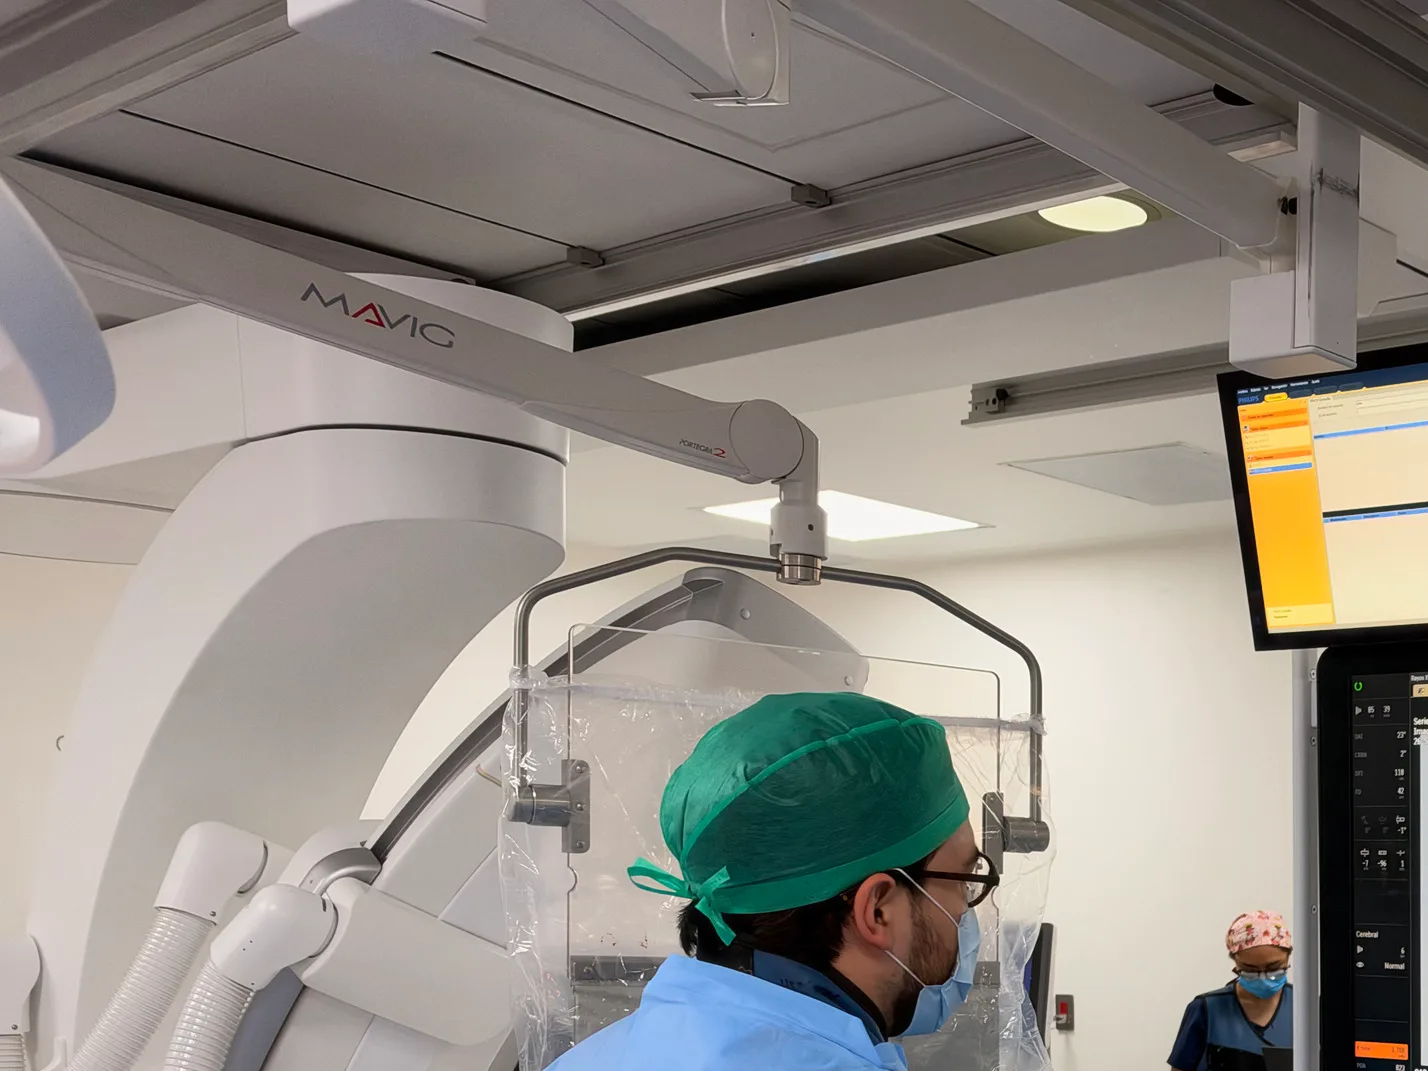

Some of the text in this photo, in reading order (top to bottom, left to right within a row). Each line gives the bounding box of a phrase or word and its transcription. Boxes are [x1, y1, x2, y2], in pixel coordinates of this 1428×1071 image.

[300, 281, 457, 349] MAVIG
[1355, 930, 1379, 939] Cerebral
[1384, 961, 1405, 971] Normal
